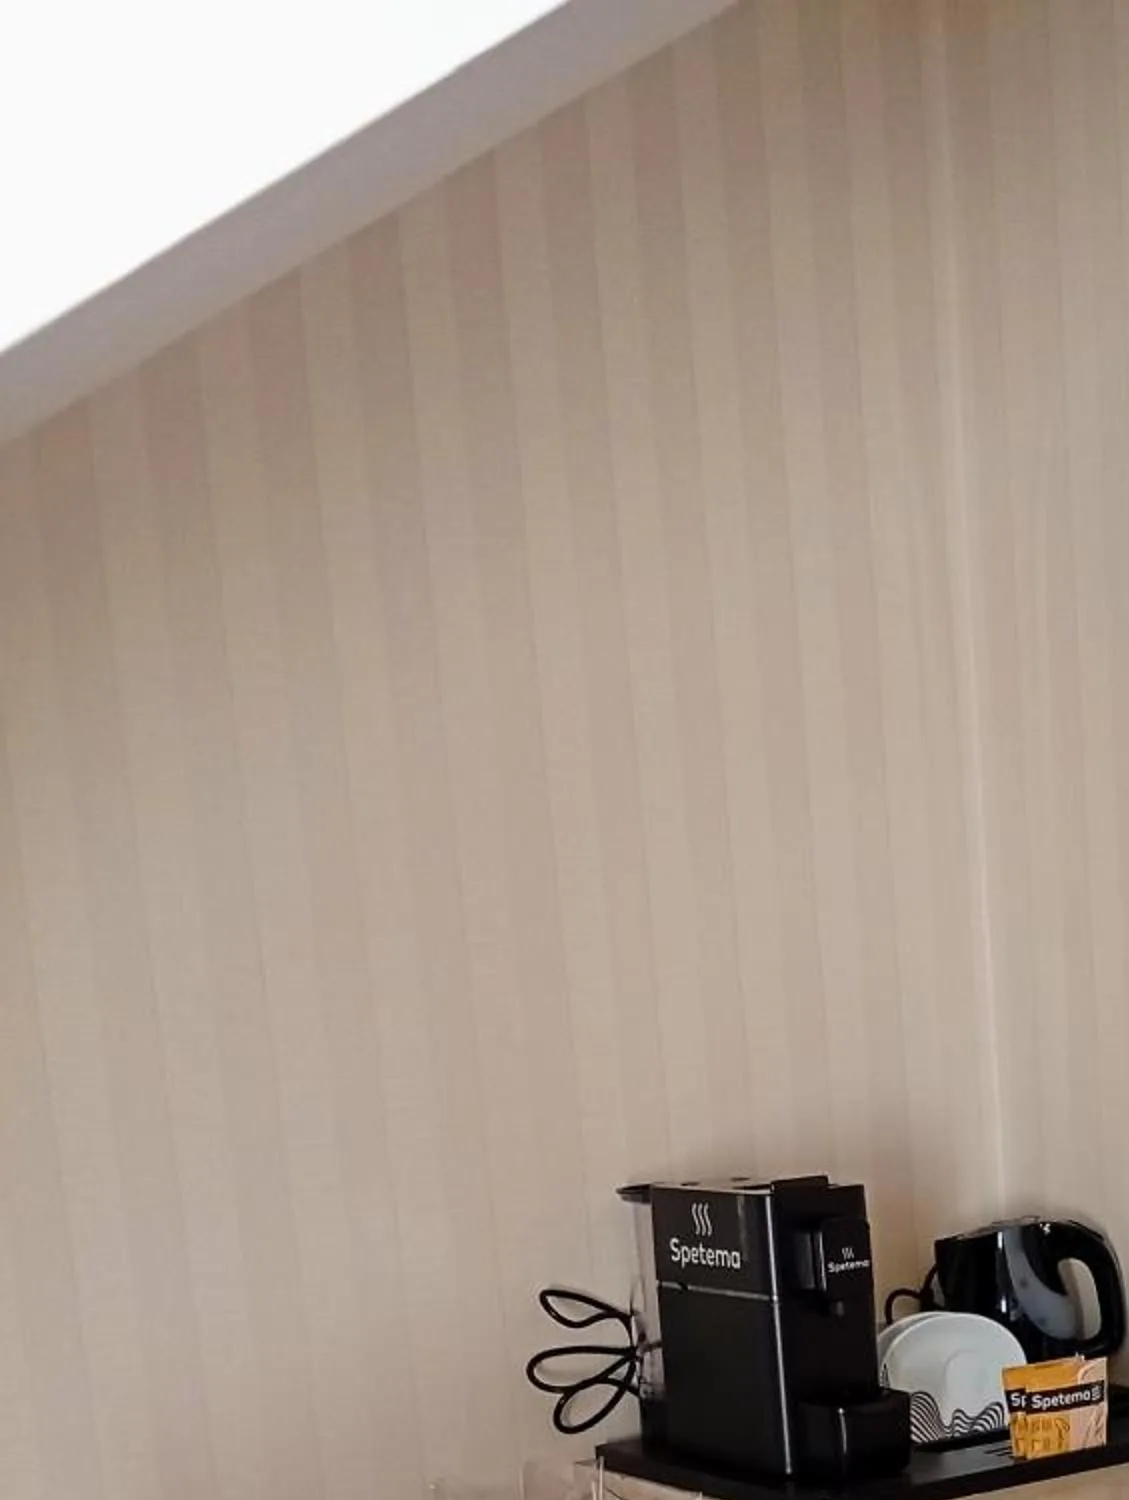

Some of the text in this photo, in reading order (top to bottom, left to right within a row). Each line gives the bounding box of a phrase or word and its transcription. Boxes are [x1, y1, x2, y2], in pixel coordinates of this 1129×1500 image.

[669, 1237, 741, 1269] Spetema
[828, 1260, 870, 1273] Spetema
[1031, 1389, 1091, 1411] Spetema
